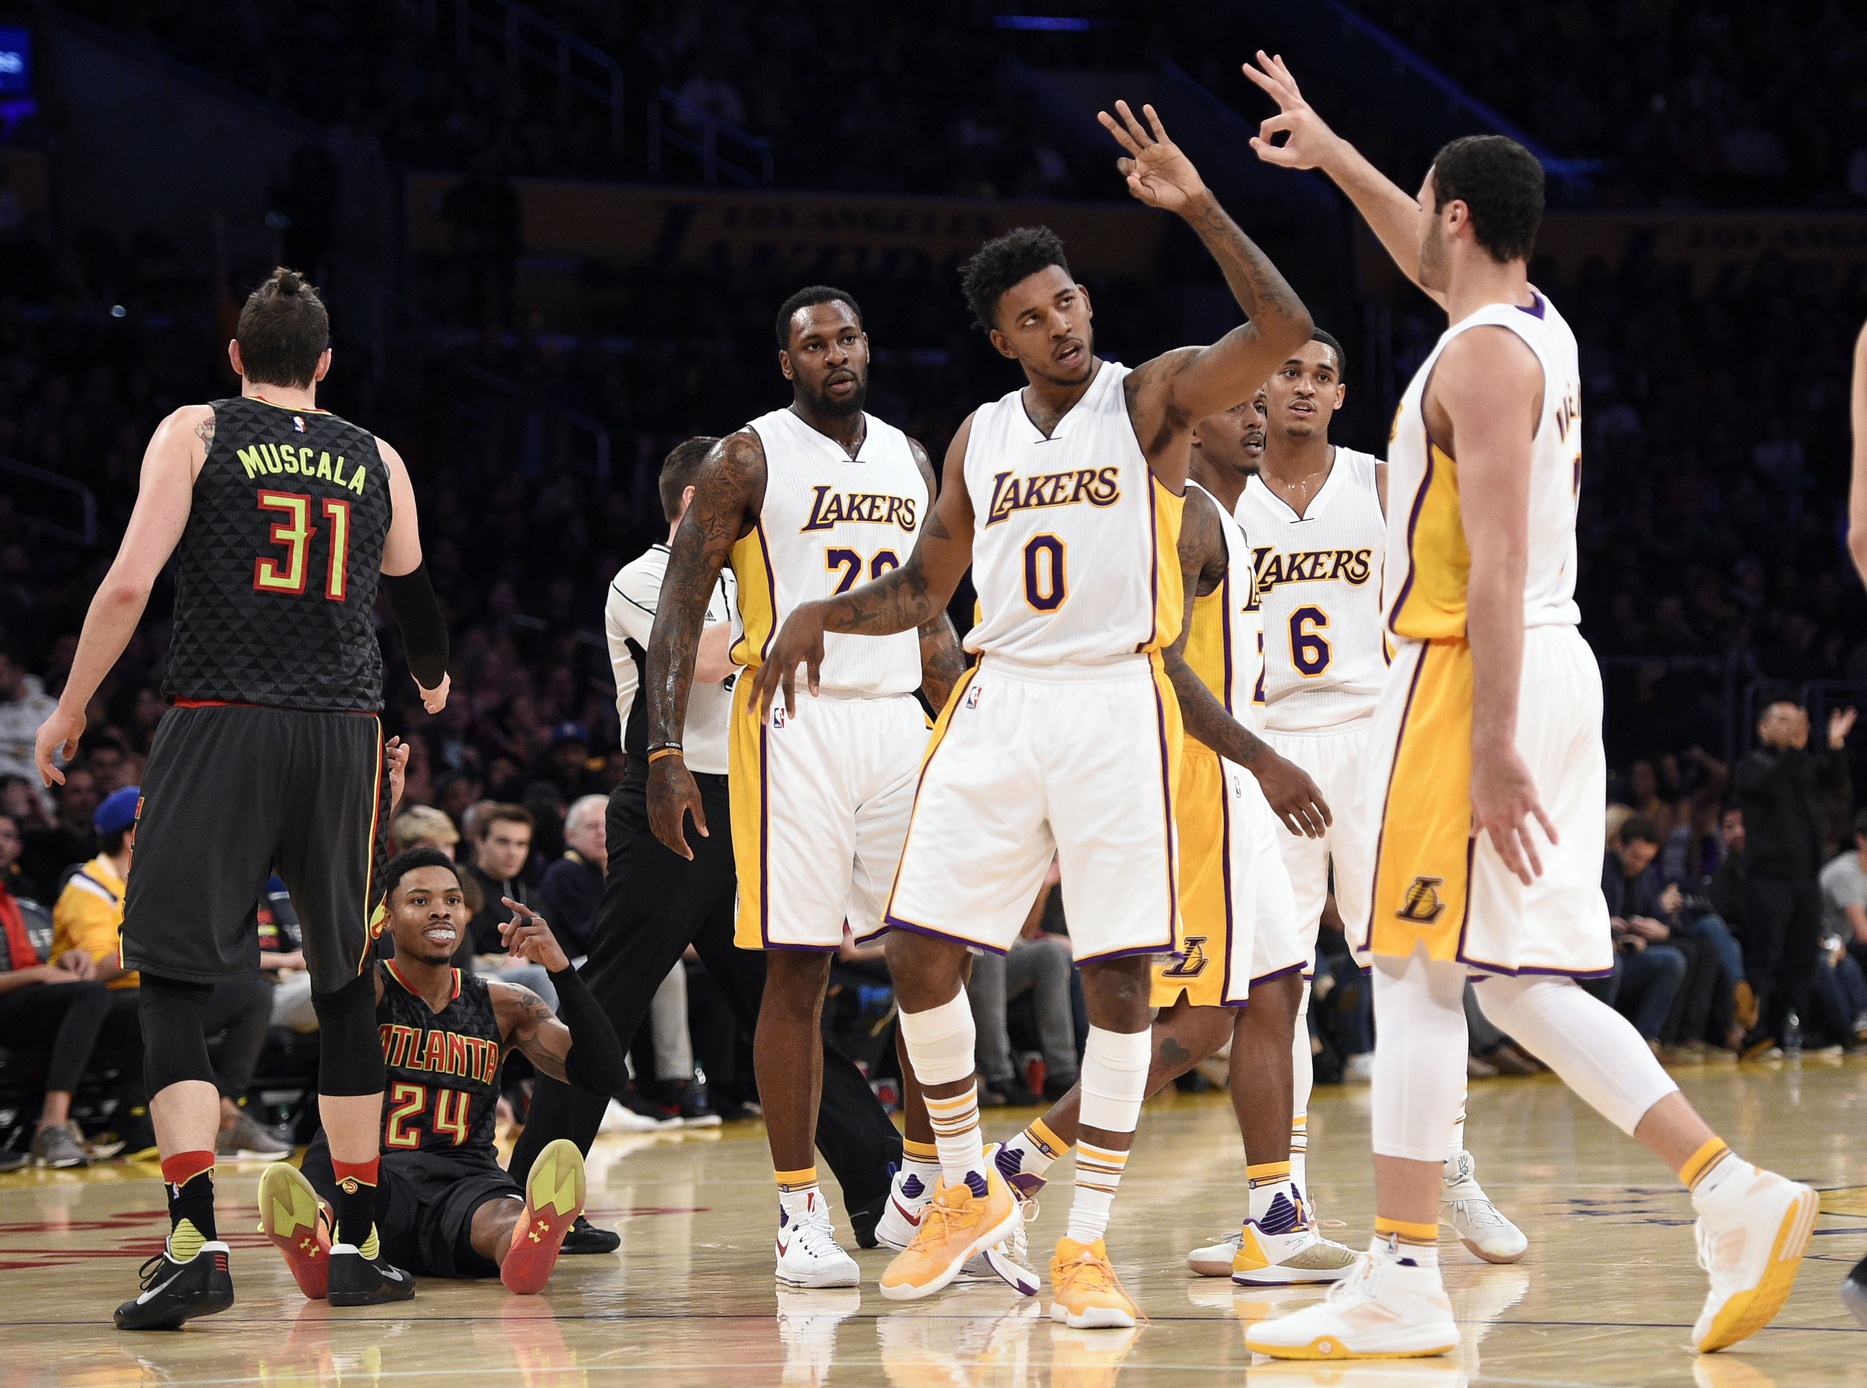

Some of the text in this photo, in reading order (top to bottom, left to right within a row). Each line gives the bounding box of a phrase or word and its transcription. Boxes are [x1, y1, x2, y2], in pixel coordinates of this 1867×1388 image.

[237, 443, 367, 495] MUSCALA
[986, 466, 1120, 530] LAKERS
[799, 484, 917, 535] LAKERS
[253, 489, 349, 601] 31
[1022, 531, 1068, 614] 0
[1250, 546, 1373, 595] LAKERS
[1287, 603, 1333, 679] 6
[385, 1081, 472, 1149] 24
